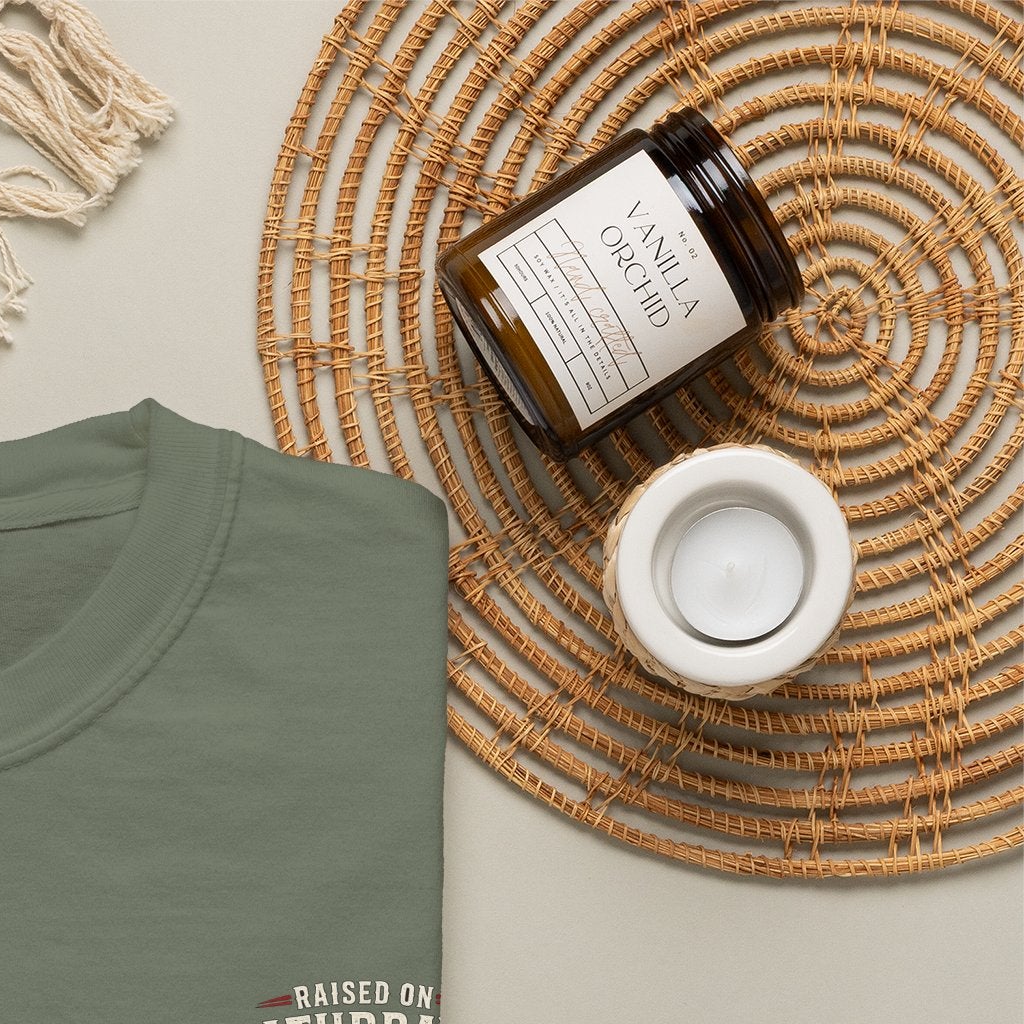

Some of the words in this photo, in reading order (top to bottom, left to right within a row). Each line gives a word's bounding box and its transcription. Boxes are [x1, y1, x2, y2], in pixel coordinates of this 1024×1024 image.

[600, 225, 670, 328] ORCHID
[626, 200, 700, 319] VANILLA
[677, 231, 688, 246] No.
[688, 248, 698, 260] 02
[533, 254, 545, 267] SOY
[544, 269, 555, 284] WAX
[568, 309, 580, 323] ALL
[584, 335, 595, 349] THE
[593, 352, 611, 380] DETAILS
[553, 324, 567, 345] NATURAL
[293, 980, 390, 1010] RAISED
[399, 982, 434, 1009] ON
